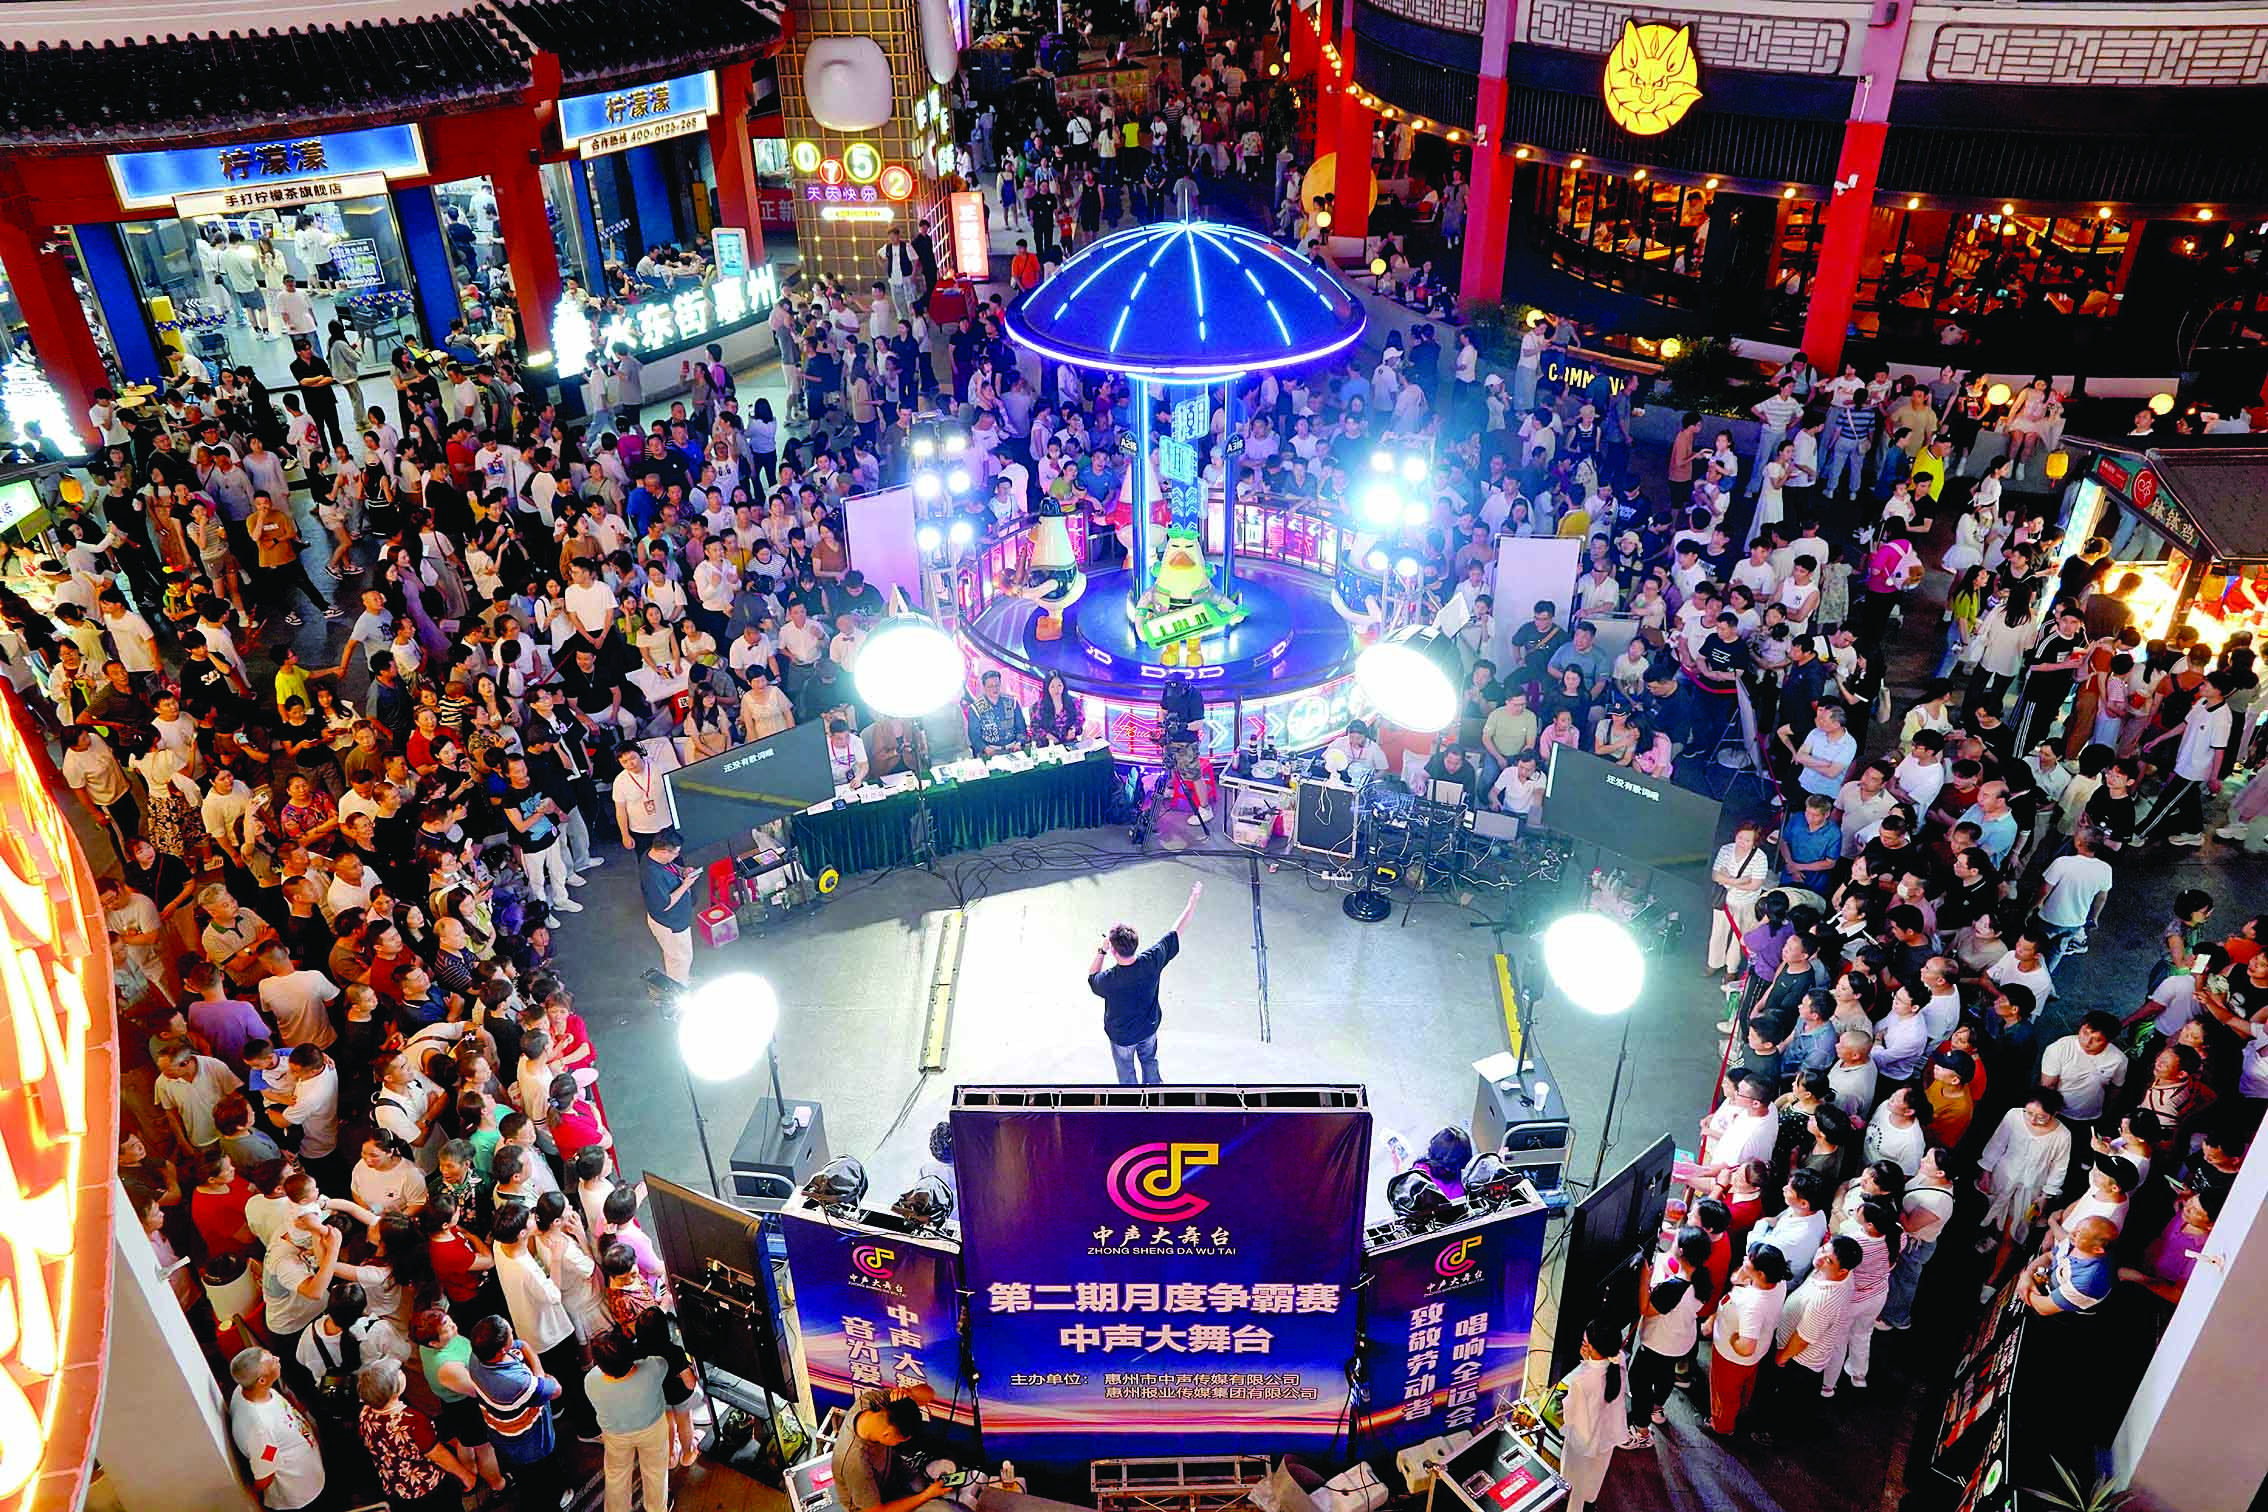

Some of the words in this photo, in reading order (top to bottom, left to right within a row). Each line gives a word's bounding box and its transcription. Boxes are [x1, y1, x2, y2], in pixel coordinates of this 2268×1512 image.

[224, 182, 342, 207] 手打柠檬茶旗舰店
[807, 186, 877, 201] 天天快乐
[1092, 1225, 1231, 1248] 中声大舞台
[1087, 1247, 1130, 1256] ZHONG
[1132, 1247, 1174, 1256] SHENG
[1177, 1247, 1194, 1256] DA
[1195, 1247, 1215, 1256] WU
[1218, 1247, 1236, 1256] TAI
[987, 1281, 1341, 1313] 第二期月度争霸赛
[1060, 1323, 1275, 1354] 中声大舞台
[1403, 1302, 1447, 1422] 致敬劳动者
[1445, 1312, 1489, 1429] 唱响全运会
[1104, 1373, 1301, 1387] 惠州市中声传媒有限公司
[1104, 1386, 1319, 1401] 惠州报业传媒集团有限公司
